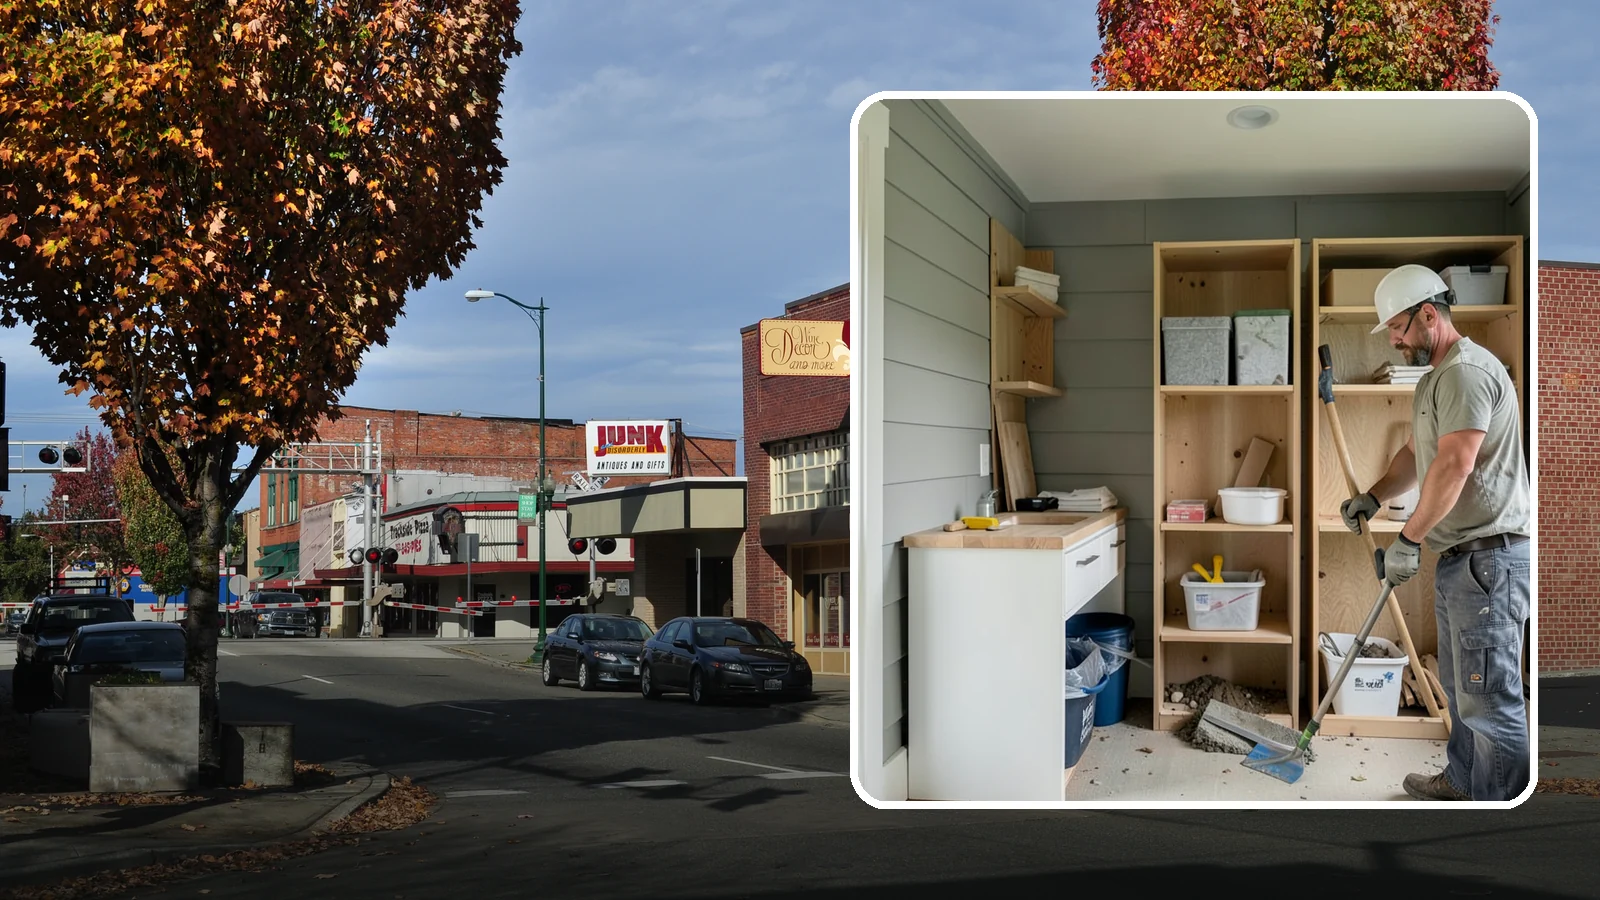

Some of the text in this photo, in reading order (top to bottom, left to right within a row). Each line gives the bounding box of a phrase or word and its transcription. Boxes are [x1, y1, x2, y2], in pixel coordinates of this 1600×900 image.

[595, 425, 665, 457] JUNK
[607, 446, 646, 454] DISORDERLY
[596, 460, 666, 470] ANTIQUES AND GIFTS
[390, 519, 429, 539] Trackside Pizza
